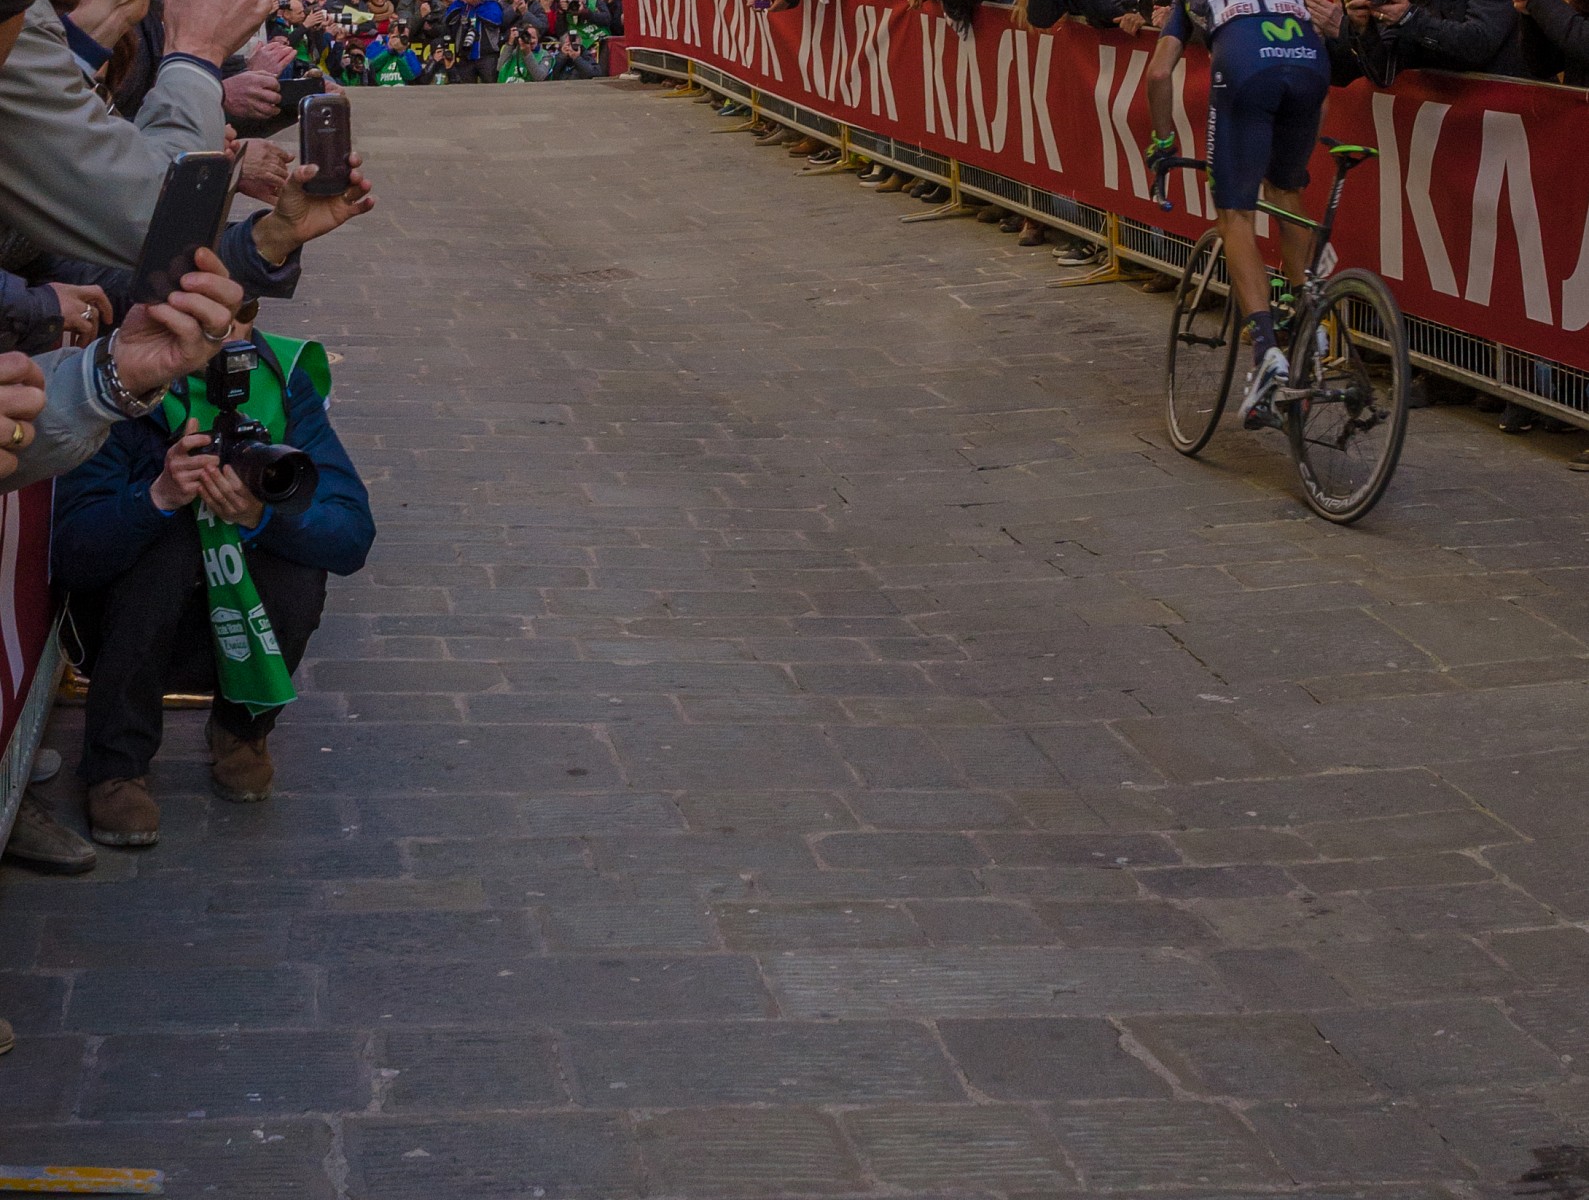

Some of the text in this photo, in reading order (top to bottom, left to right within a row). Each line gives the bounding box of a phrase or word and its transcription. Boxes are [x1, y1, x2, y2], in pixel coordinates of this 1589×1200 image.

[1259, 45, 1318, 59] movistar
[920, 12, 1063, 173] KASK
[1207, 106, 1217, 164] movistar
